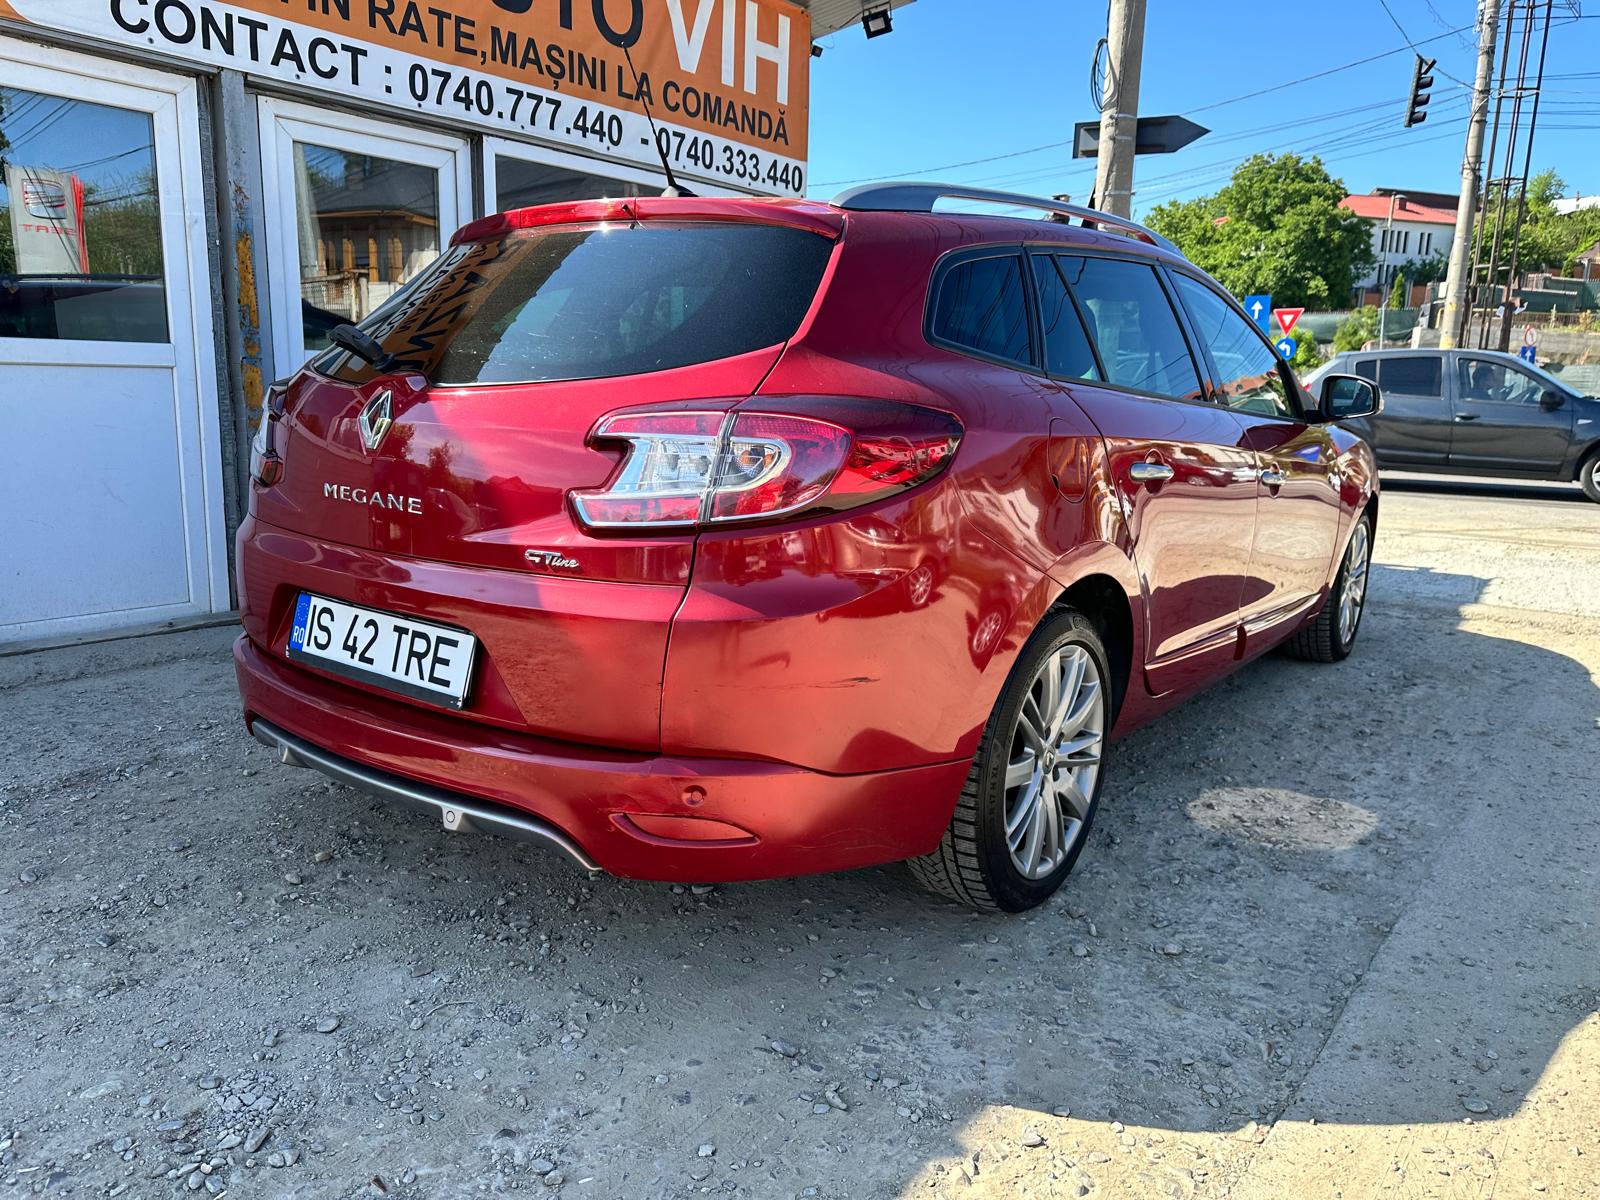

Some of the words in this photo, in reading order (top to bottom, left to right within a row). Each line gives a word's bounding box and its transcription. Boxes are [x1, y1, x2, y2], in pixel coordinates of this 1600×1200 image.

[110, 0, 368, 86] CONTACT
[408, 63, 623, 146] 0740.777.440
[664, 0, 791, 106] VIH
[617, 65, 654, 106] LA
[662, 80, 790, 146] COMANDĂ
[323, 482, 422, 514] MEGANE
[292, 625, 305, 644] RO
[306, 604, 335, 651] IS
[342, 614, 379, 666] 42
[391, 625, 459, 688] TRE
